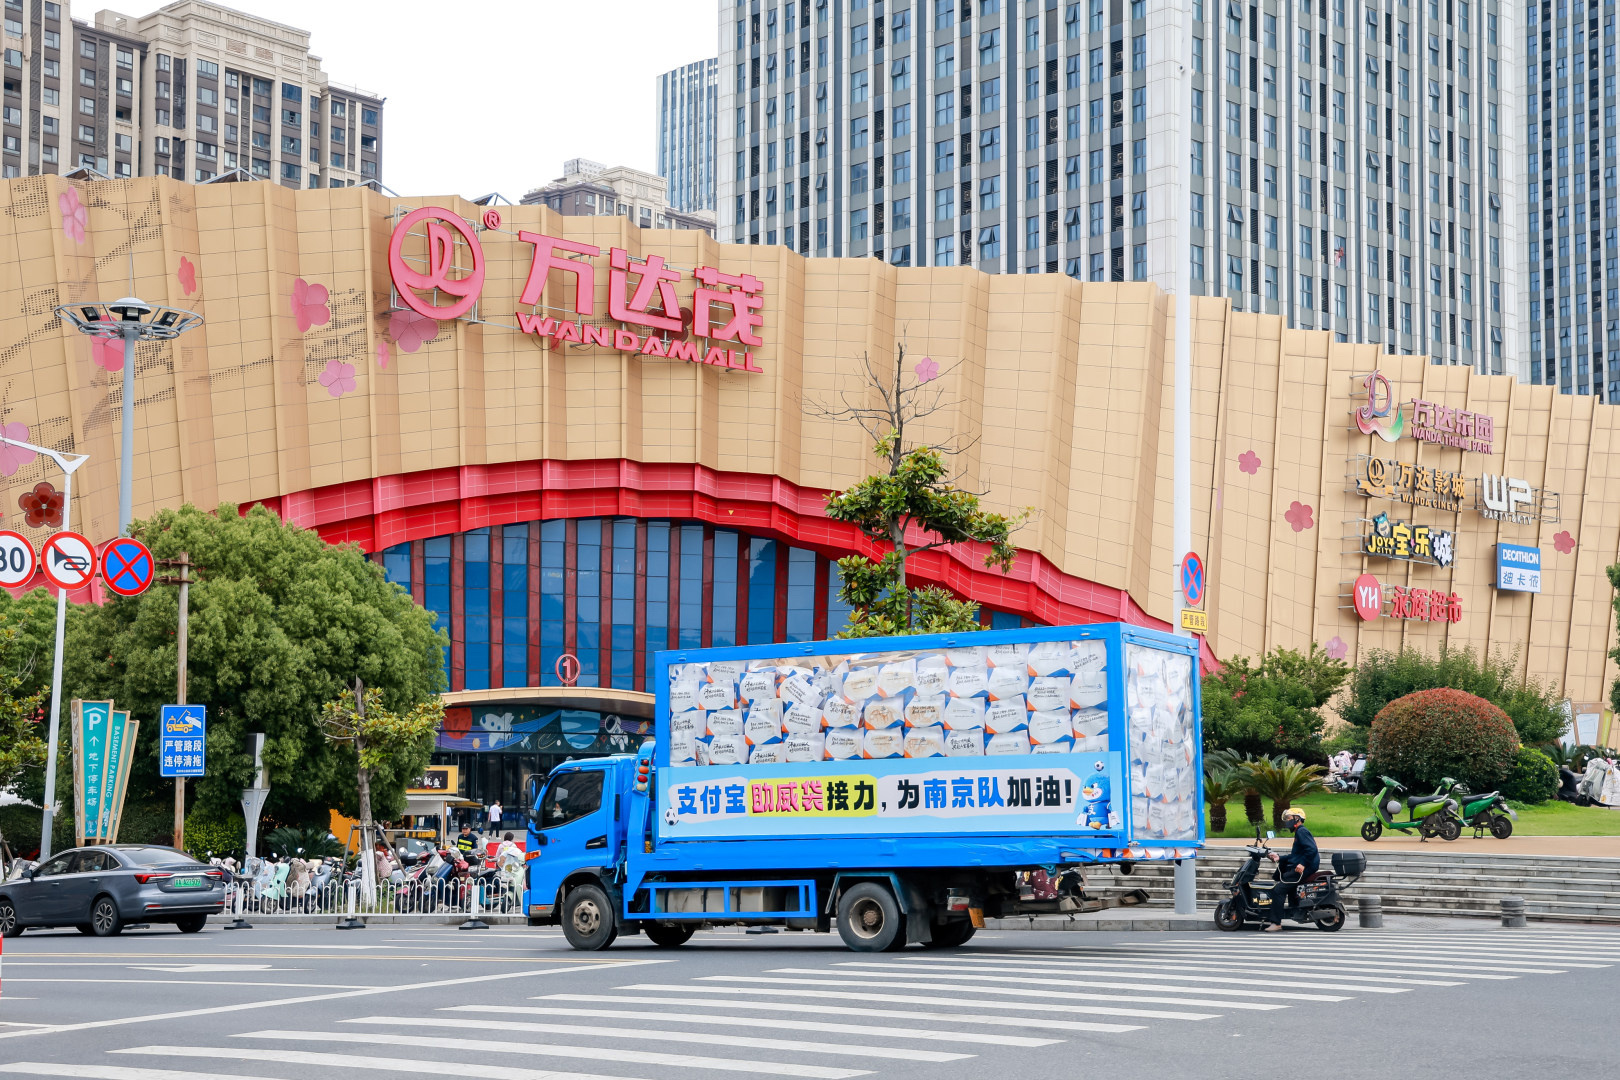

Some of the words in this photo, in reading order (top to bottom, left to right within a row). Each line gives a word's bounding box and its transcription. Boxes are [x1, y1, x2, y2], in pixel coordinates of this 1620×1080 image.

[518, 230, 763, 347] 万达茂
[515, 311, 764, 373] WANDAMALL
[1411, 398, 1493, 442] 万达乐园
[1411, 427, 1441, 443] WANDA
[1443, 433, 1471, 450] THEME
[1471, 440, 1493, 455] PARK
[1396, 461, 1465, 499] 万达影城
[1401, 493, 1430, 507] WANDA
[1432, 499, 1463, 513] CINEMA
[1368, 535, 1389, 552] JOY
[1393, 523, 1453, 566] 宝乐城
[1503, 548, 1539, 565] DECATHLON
[1503, 571, 1539, 588] 迪卡侬
[1359, 585, 1378, 609] YH
[1391, 585, 1463, 624] 永辉超市
[89, 713, 102, 730] P
[111, 725, 120, 763] BASEMENT
[165, 740, 202, 752] 严管路段
[164, 755, 202, 767] 违停清拖
[87, 752, 99, 806] 地下停车场
[106, 765, 116, 798] PARKING
